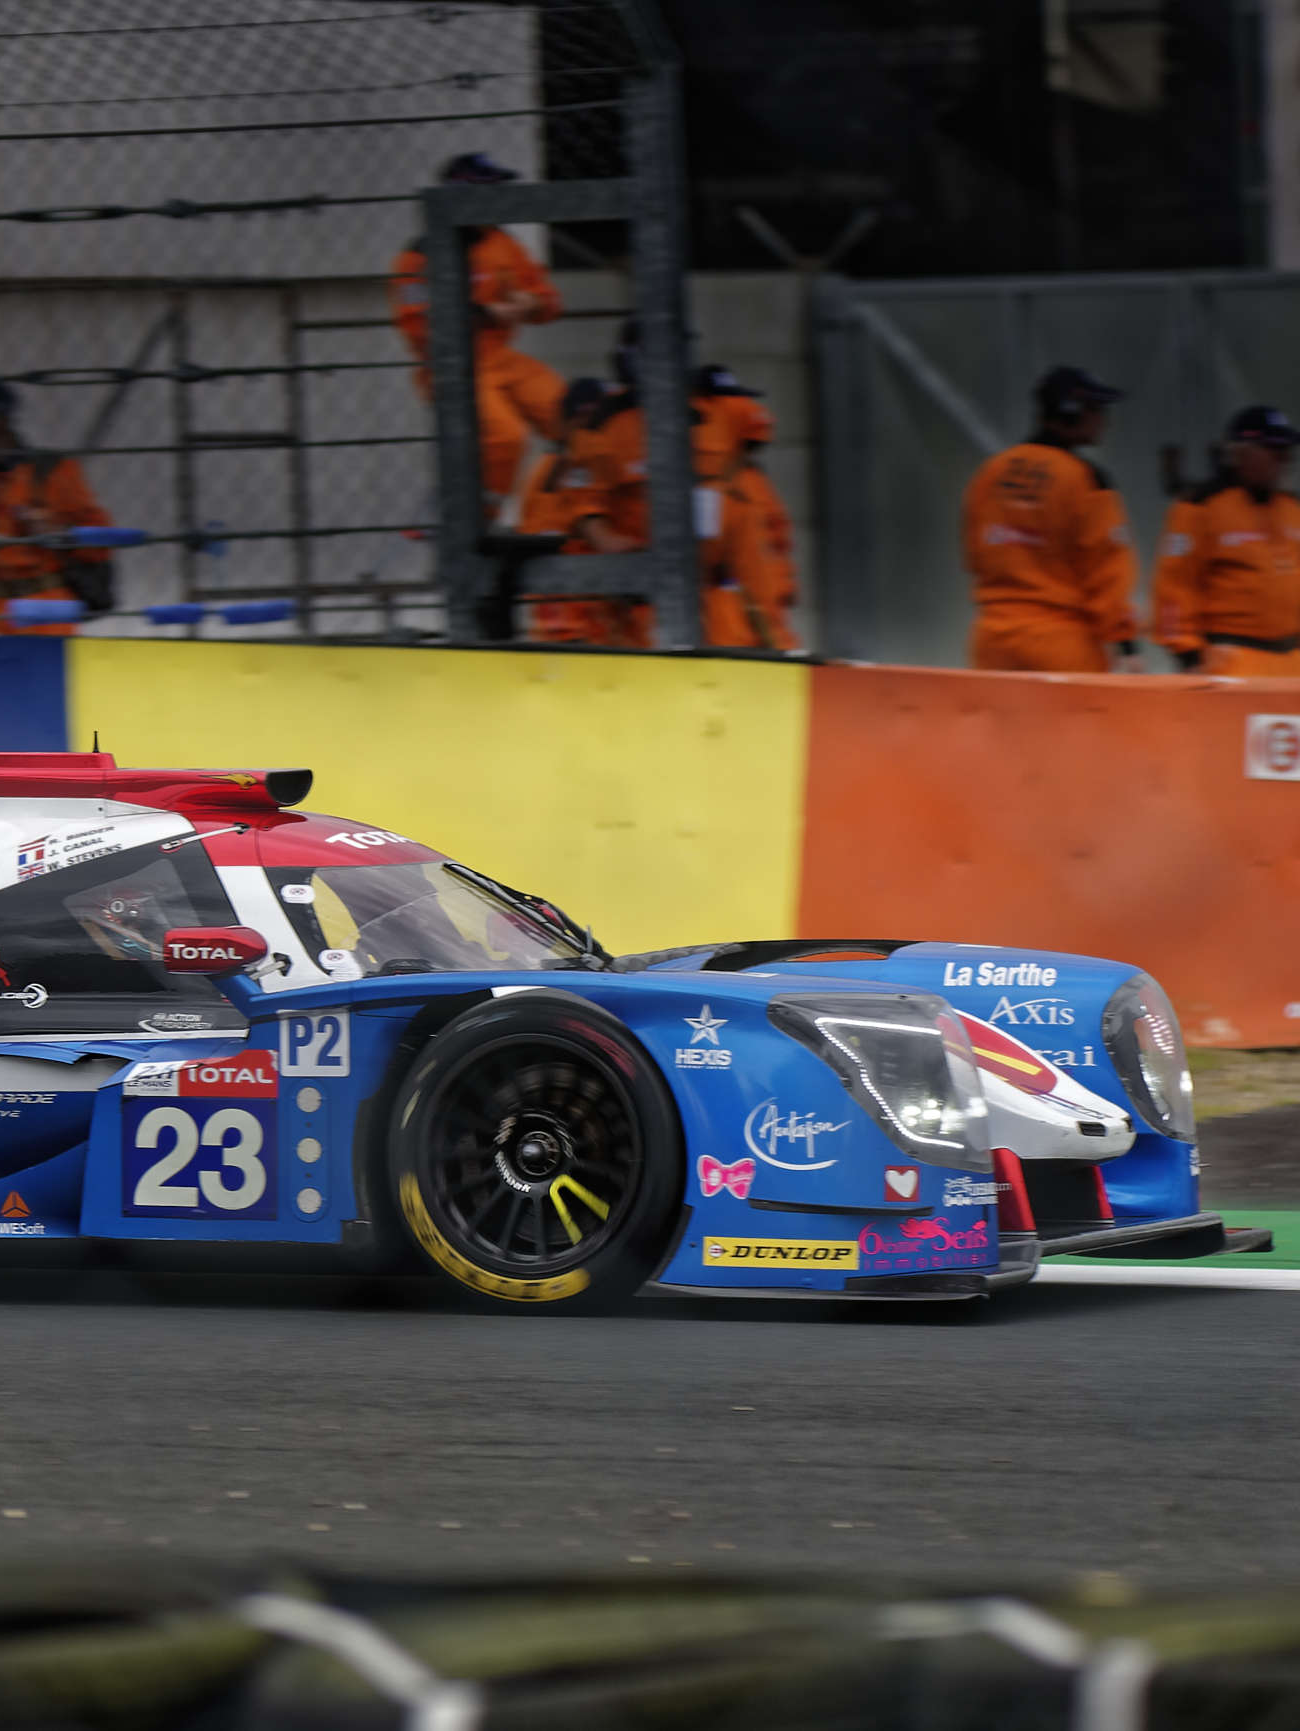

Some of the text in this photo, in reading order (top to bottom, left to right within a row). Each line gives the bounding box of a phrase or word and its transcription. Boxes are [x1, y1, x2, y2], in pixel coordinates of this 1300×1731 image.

[63, 837, 105, 852] CANAL
[324, 831, 417, 849] TOTA
[66, 844, 123, 866] STEVENS
[168, 943, 244, 961] TOTAL
[943, 961, 1058, 986] La Sarthe
[288, 1015, 343, 1068] P2
[675, 1048, 732, 1066] HEXIS
[142, 1080, 173, 1088] MANS
[133, 1106, 268, 1210] 23
[730, 1244, 852, 1262] DUNLOP
